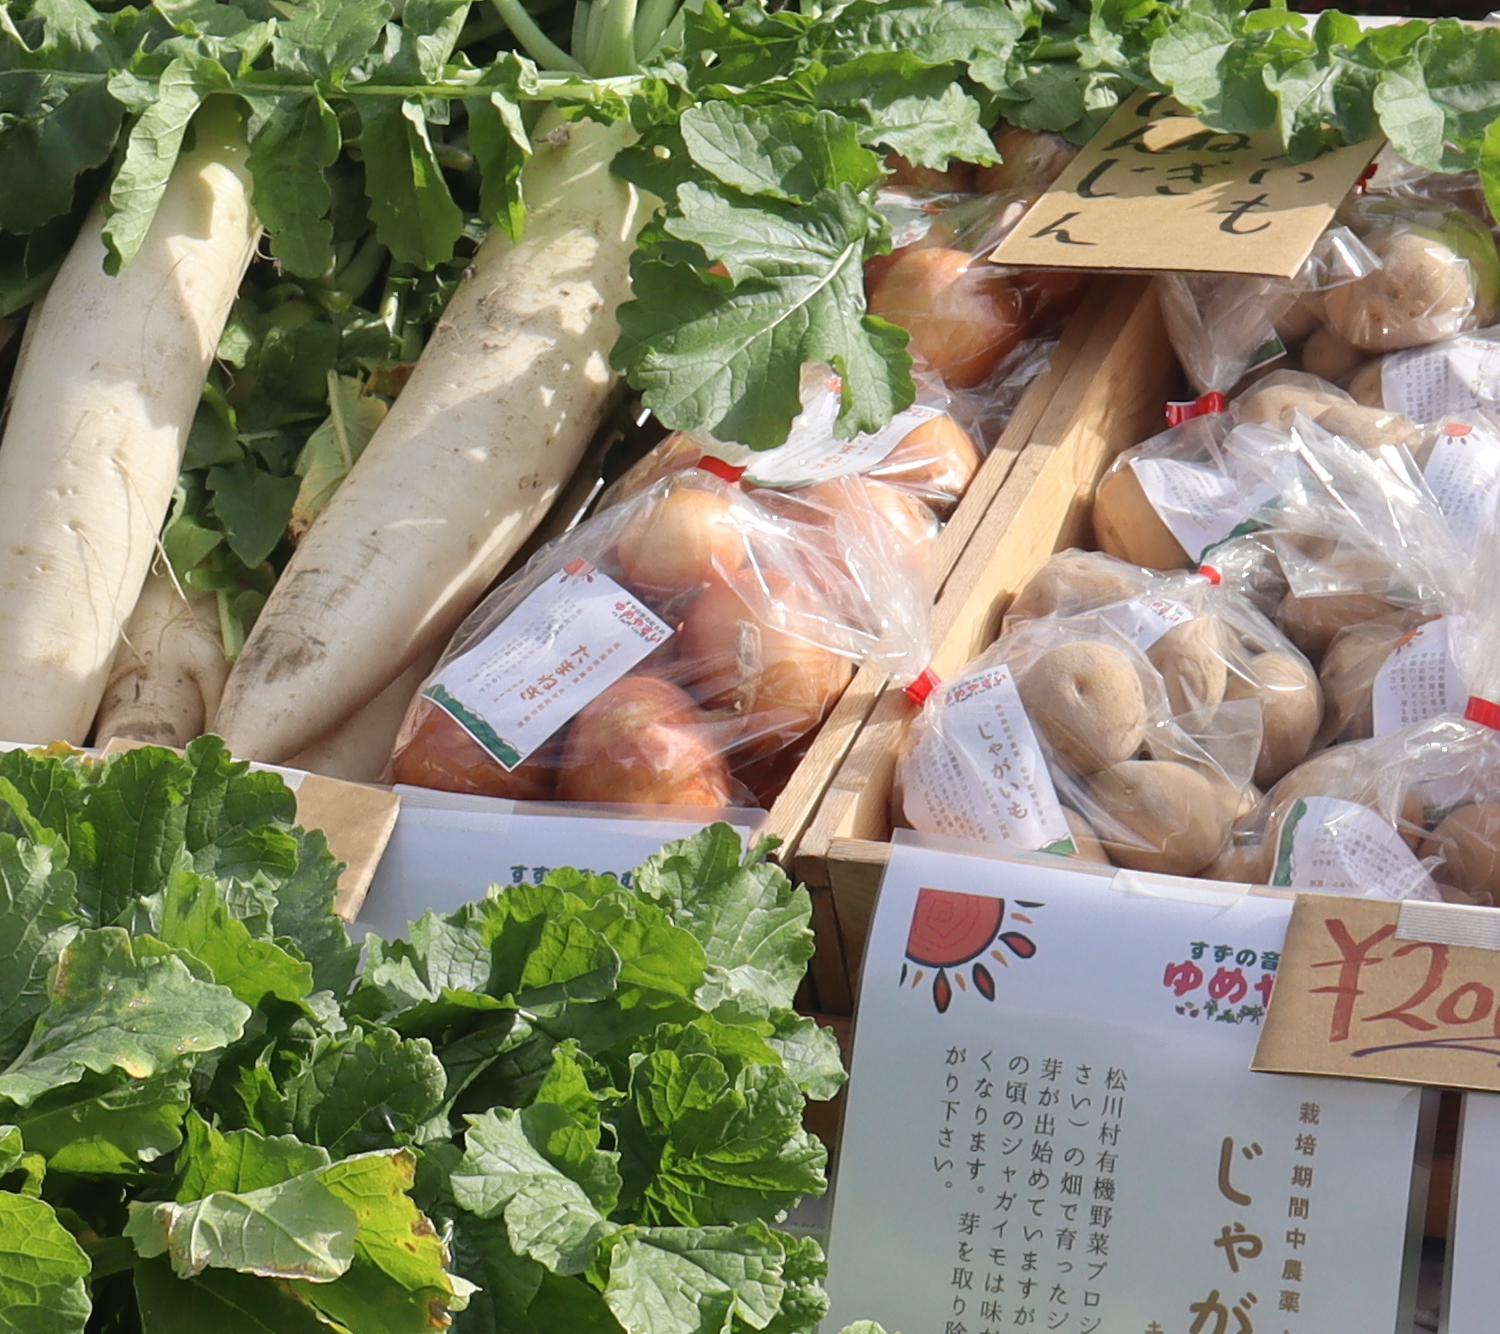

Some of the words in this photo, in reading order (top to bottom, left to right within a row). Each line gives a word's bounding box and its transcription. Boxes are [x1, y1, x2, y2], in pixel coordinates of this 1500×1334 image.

[519, 644, 591, 702] たまねぎ
[978, 721, 1029, 820] じゃがいも
[933, 1045, 967, 1190] がり下さい。
